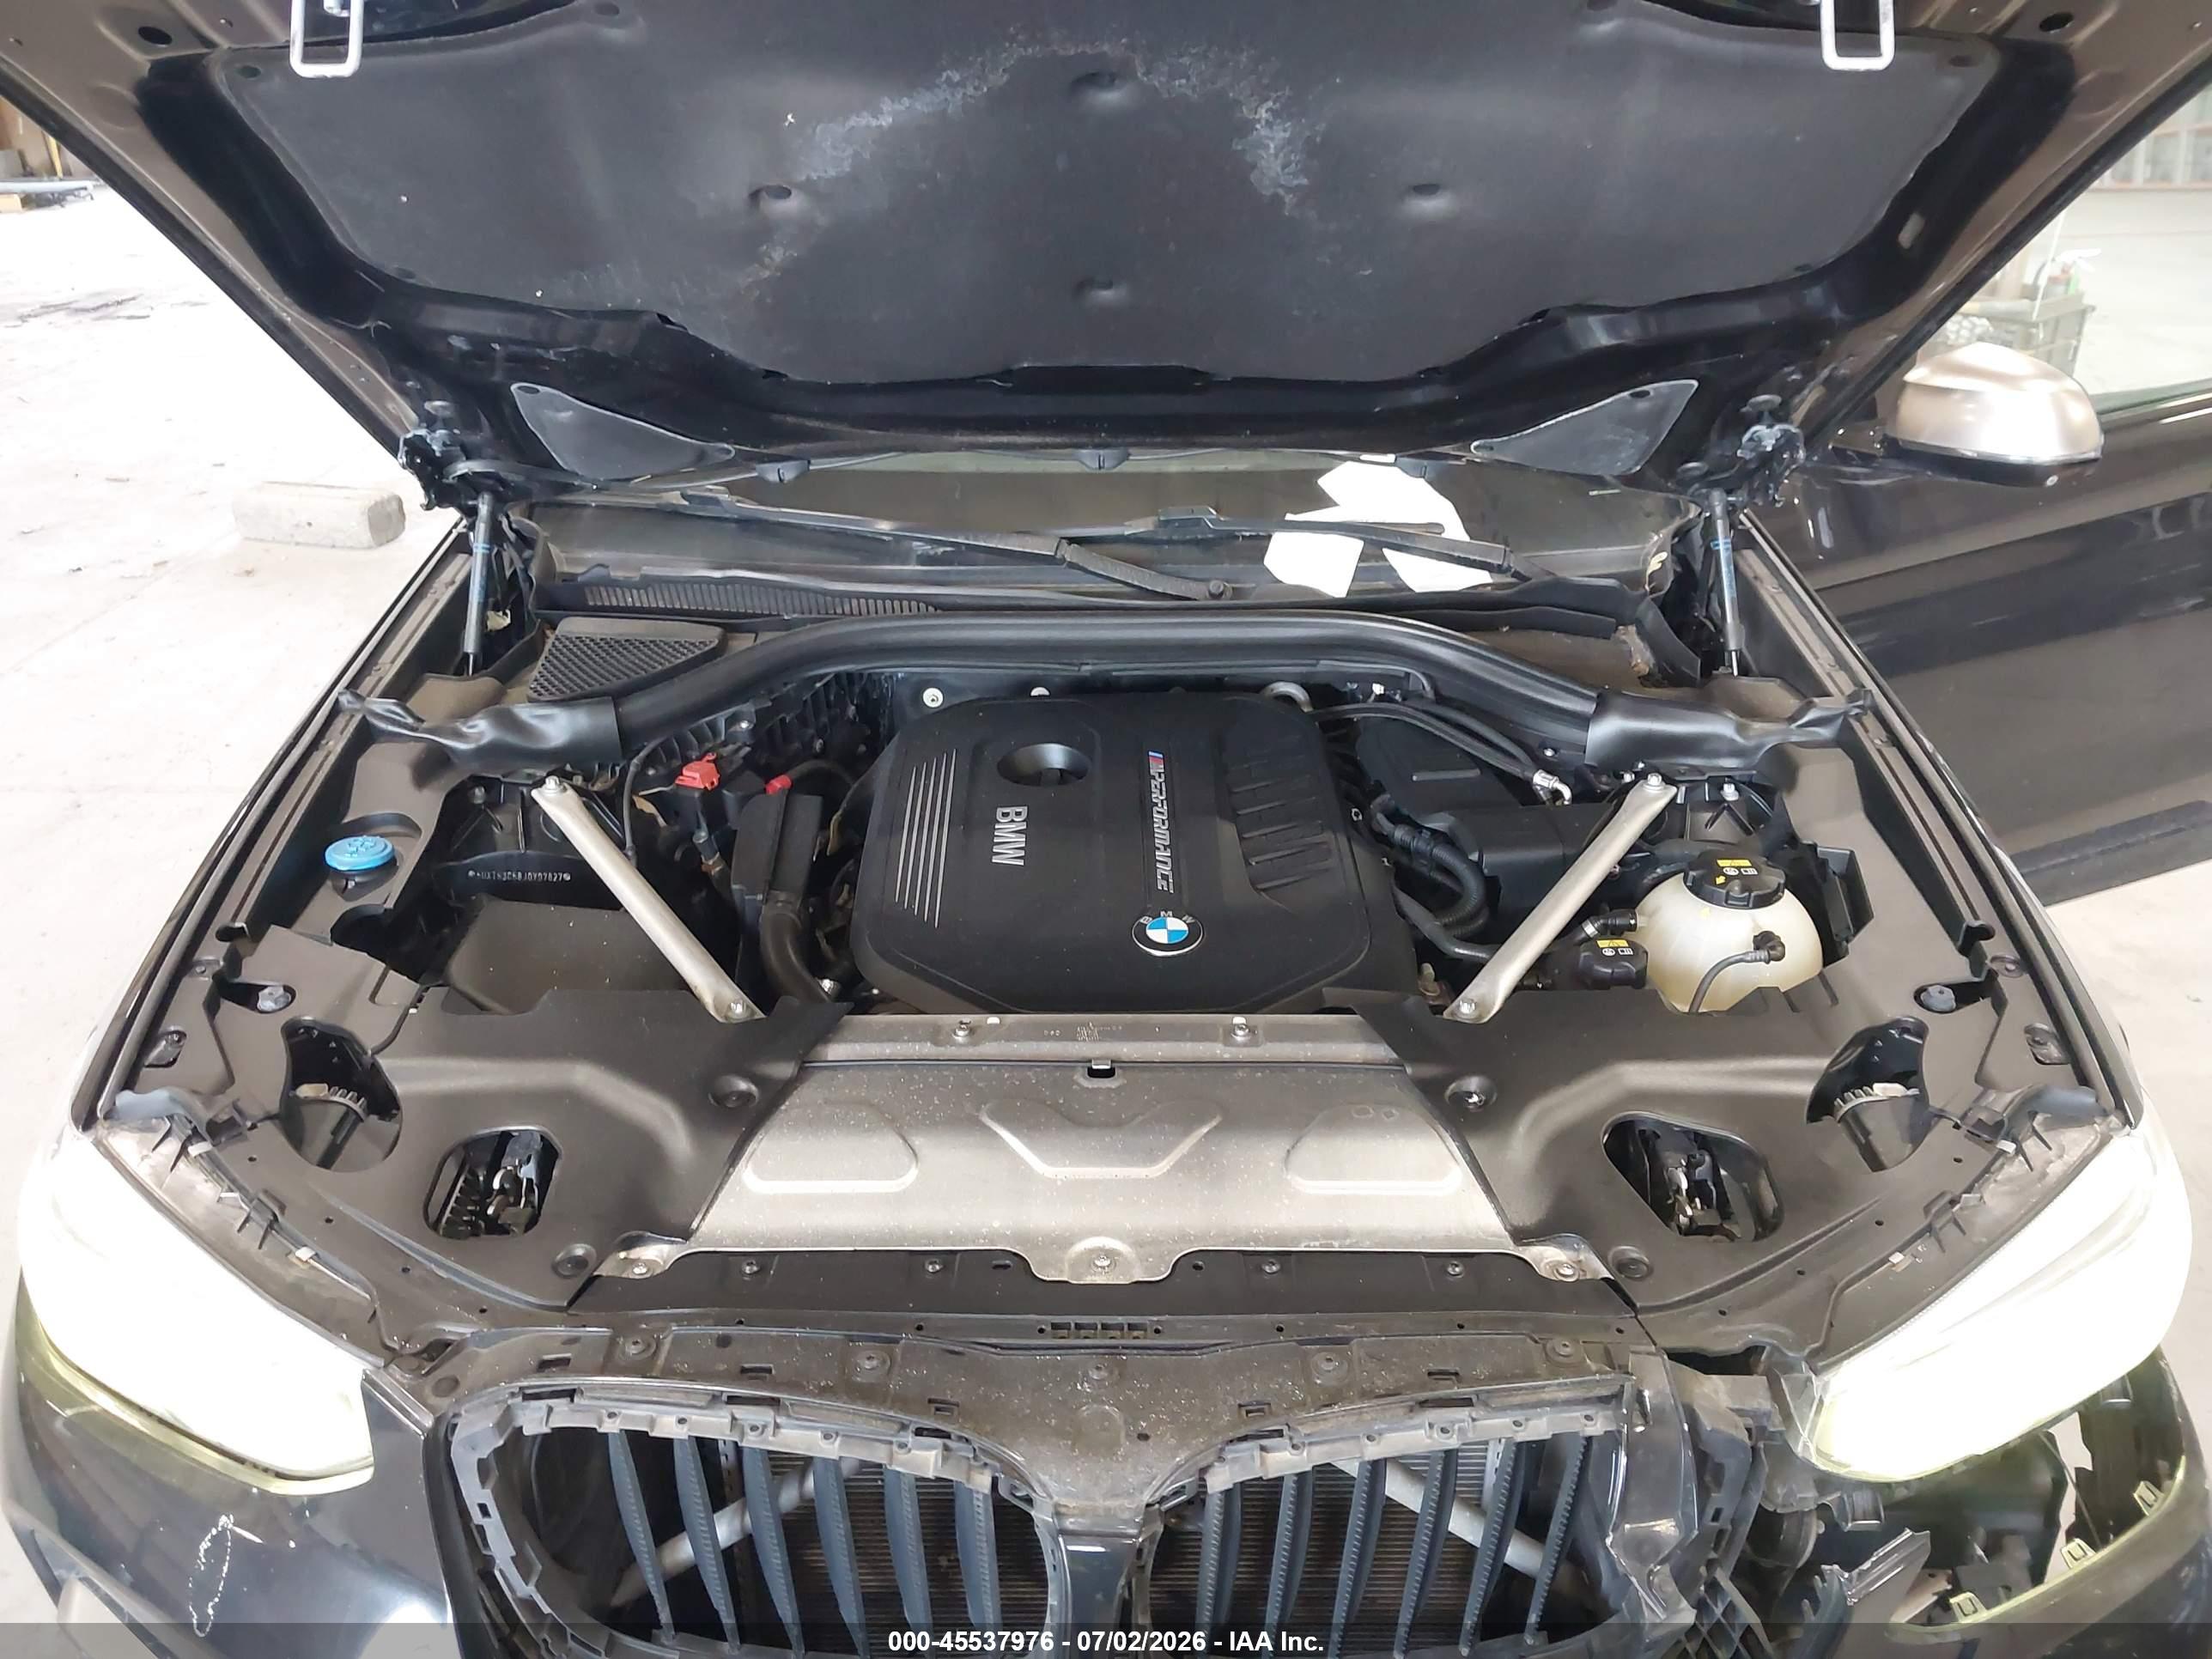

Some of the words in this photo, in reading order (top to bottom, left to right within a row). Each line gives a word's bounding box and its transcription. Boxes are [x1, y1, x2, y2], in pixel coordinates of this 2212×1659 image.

[992, 805, 1028, 866] BMW
[1151, 770, 1174, 894] PERFORMANCE
[1139, 910, 1195, 925] BMW
